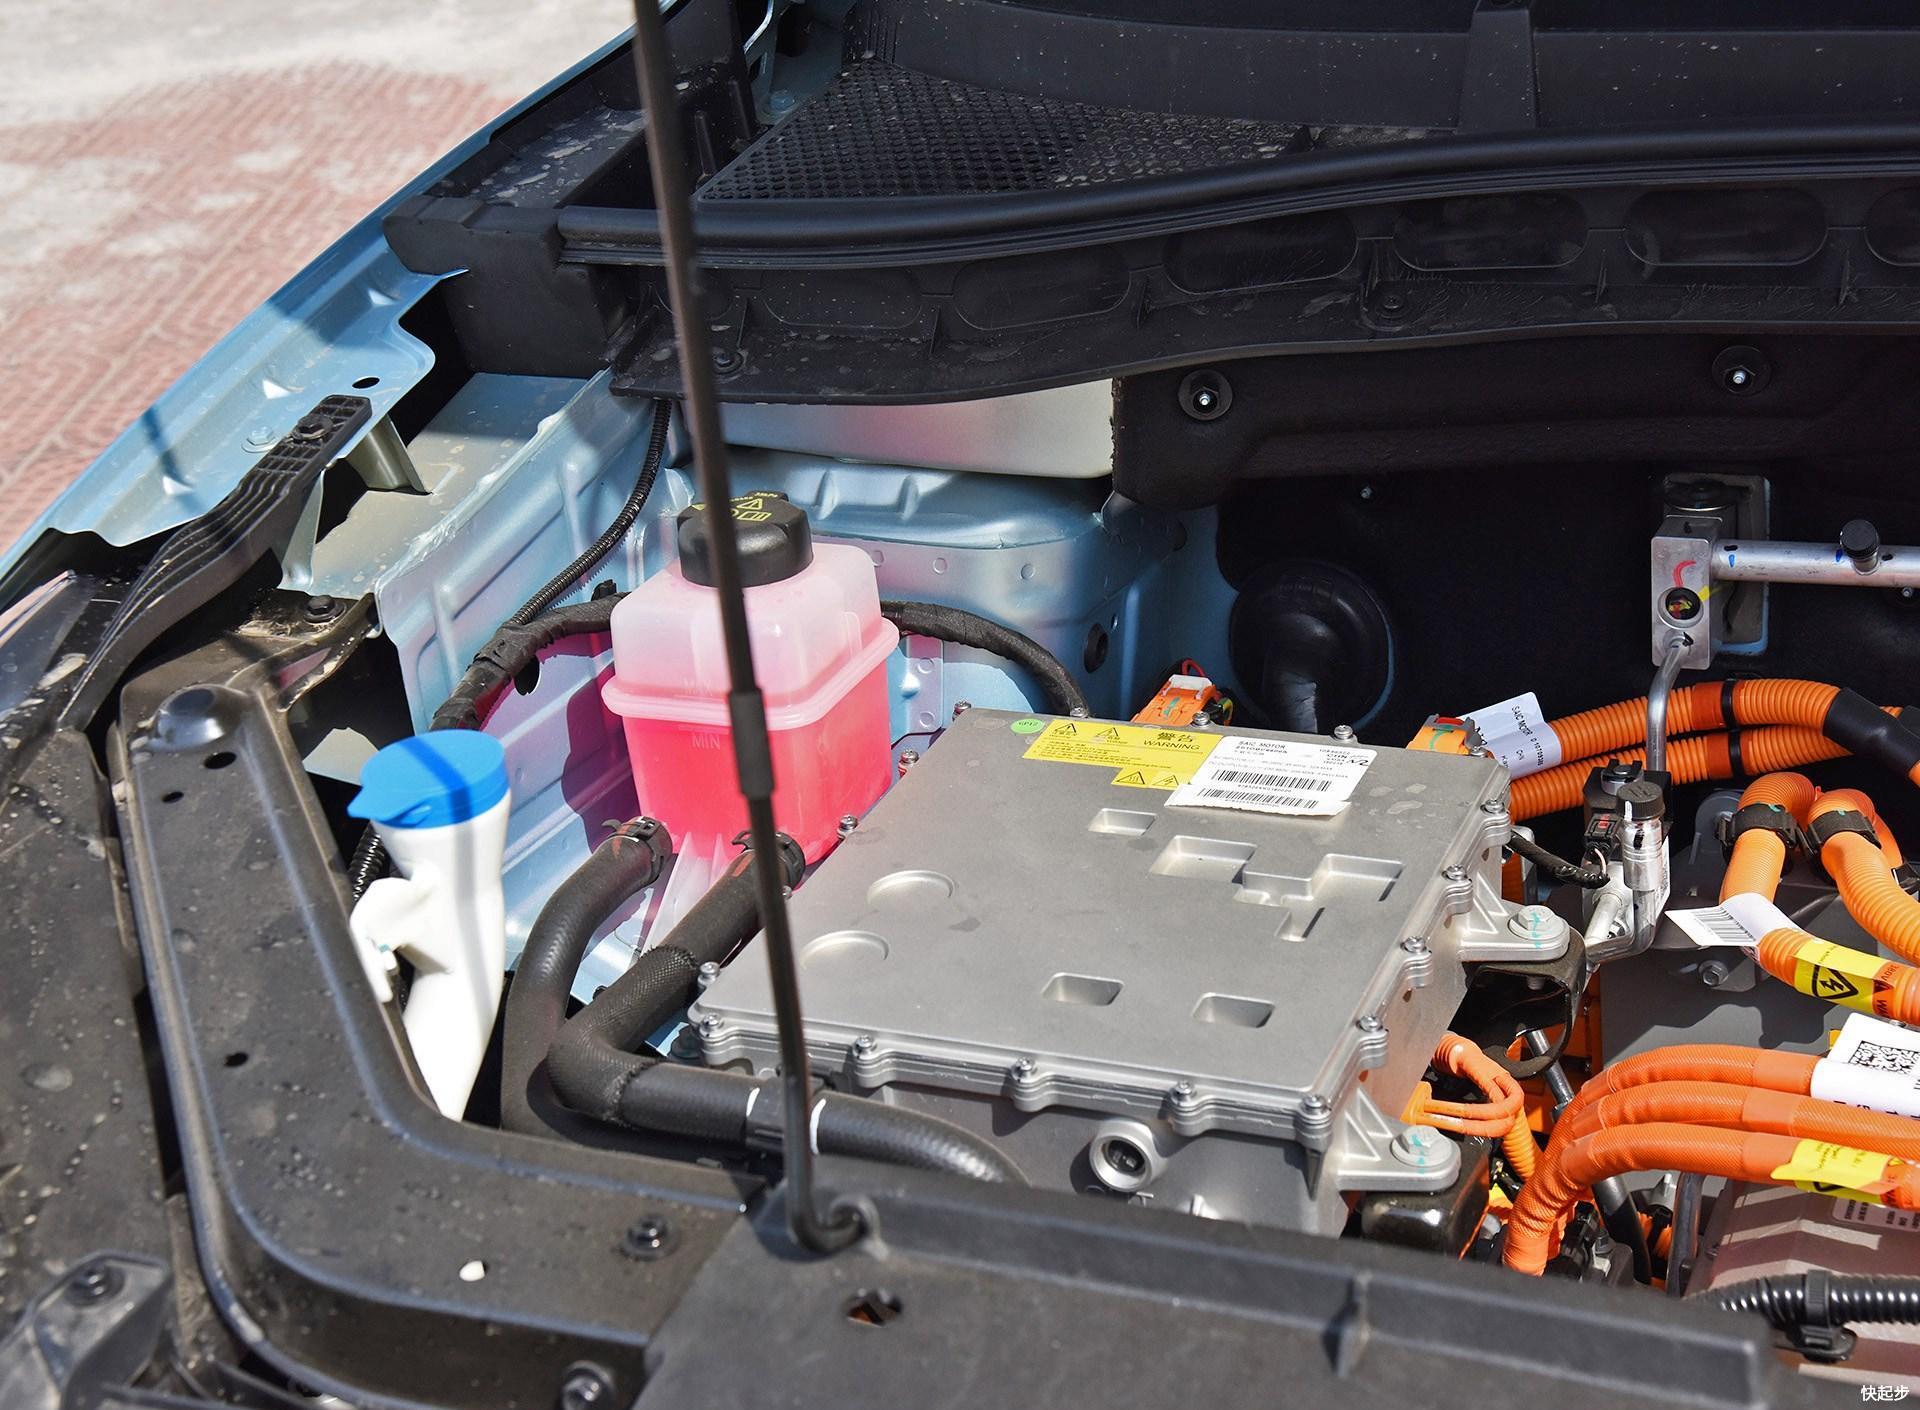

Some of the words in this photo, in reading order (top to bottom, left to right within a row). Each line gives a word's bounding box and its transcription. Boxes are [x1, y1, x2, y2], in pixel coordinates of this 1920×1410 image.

[691, 732, 721, 750] MIN
[1143, 739, 1200, 750] WARNING
[1259, 742, 1286, 750] MOTOR
